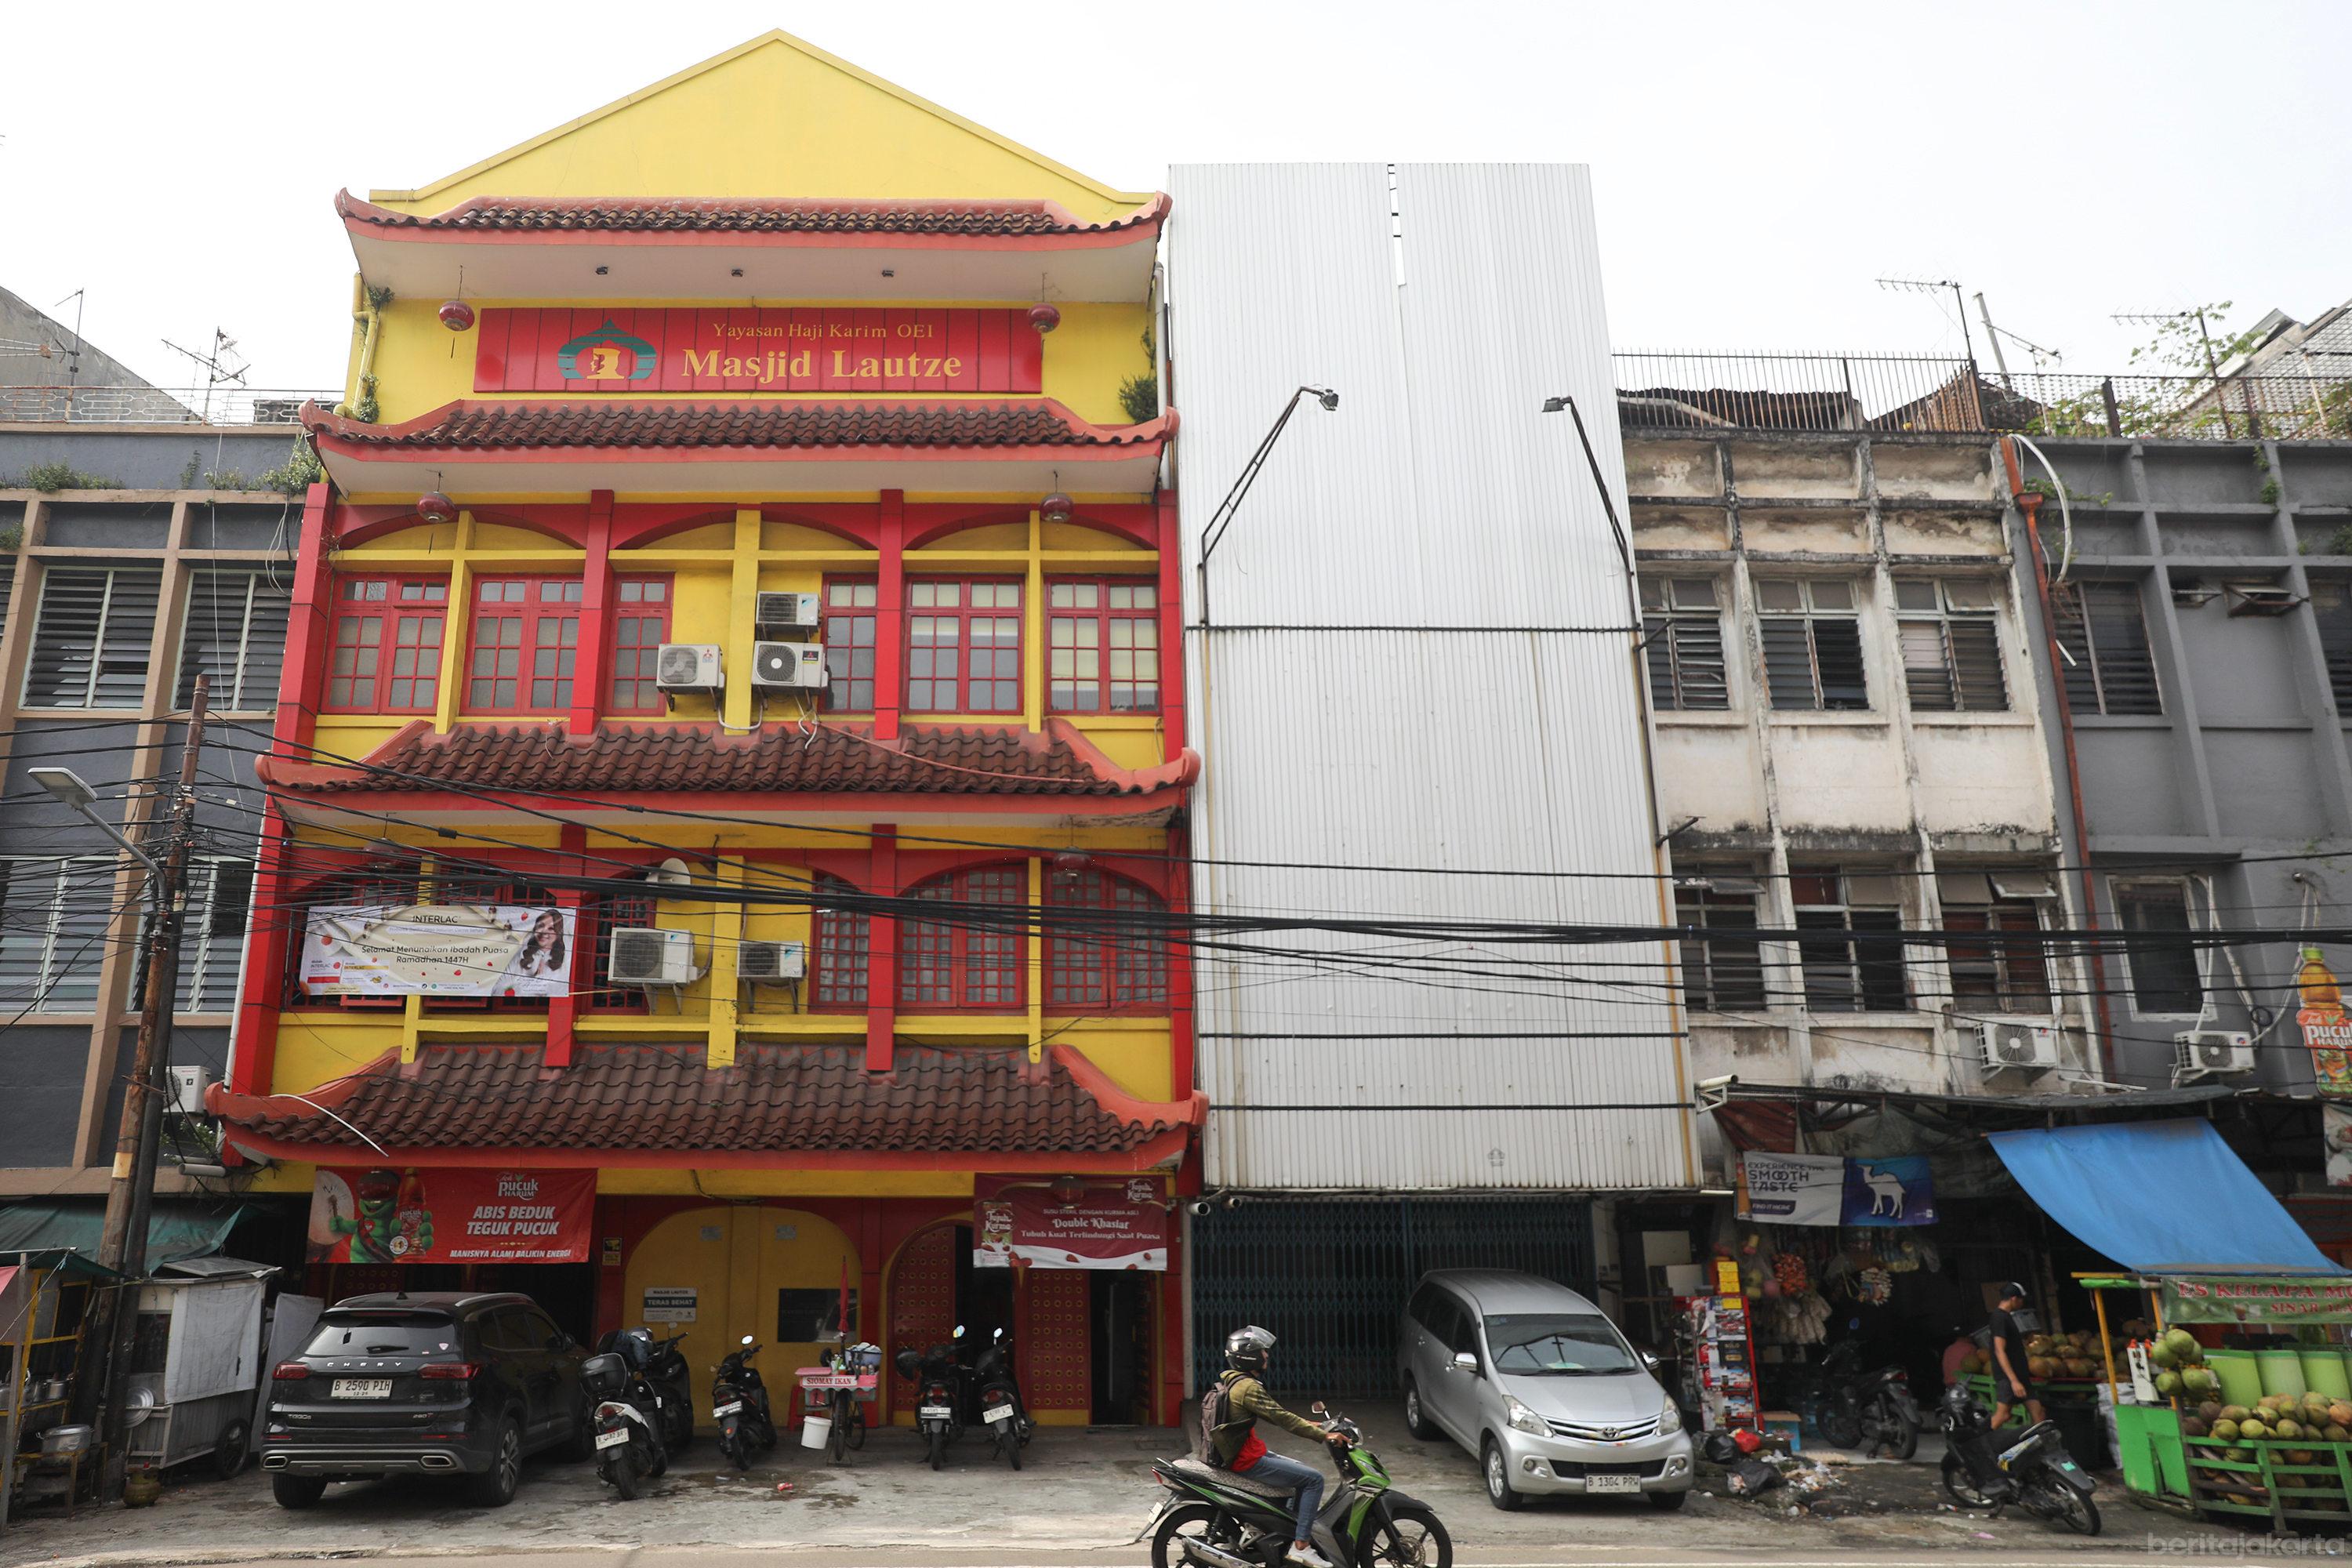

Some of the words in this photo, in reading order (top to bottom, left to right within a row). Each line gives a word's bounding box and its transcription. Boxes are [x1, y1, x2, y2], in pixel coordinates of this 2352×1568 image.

[713, 323, 782, 339] Yayasan
[788, 324, 822, 340] Haji
[829, 324, 886, 338] Karim
[896, 324, 933, 338] OEI
[681, 349, 811, 383] Masjid
[831, 350, 961, 378] Lautze
[412, 915, 458, 924] INTERLAC
[361, 946, 394, 954] Selamat
[397, 946, 448, 954] Menunaikan
[396, 956, 442, 964] Ramadhan
[2306, 1022, 2352, 1045] pucu
[1748, 1170, 1809, 1181] SMOOTH
[498, 1178, 539, 1197] pucuk
[1749, 1181, 1798, 1192] TASTE
[504, 1191, 535, 1200] HARUM
[473, 1206, 507, 1219] ABIS
[508, 1206, 556, 1220] BEDUK
[466, 1221, 512, 1235] TEGUK
[514, 1221, 560, 1235] PUCUK
[1052, 1218, 1088, 1229] Double
[1091, 1218, 1130, 1229] Khasiat
[2178, 1282, 2209, 1298] ES
[2214, 1283, 2318, 1298] KELAPA
[2270, 1302, 2319, 1313] SINAR
[335, 1381, 341, 1391] B
[346, 1381, 369, 1391] 2590
[373, 1381, 390, 1391] PIH
[1588, 1476, 1593, 1486] B
